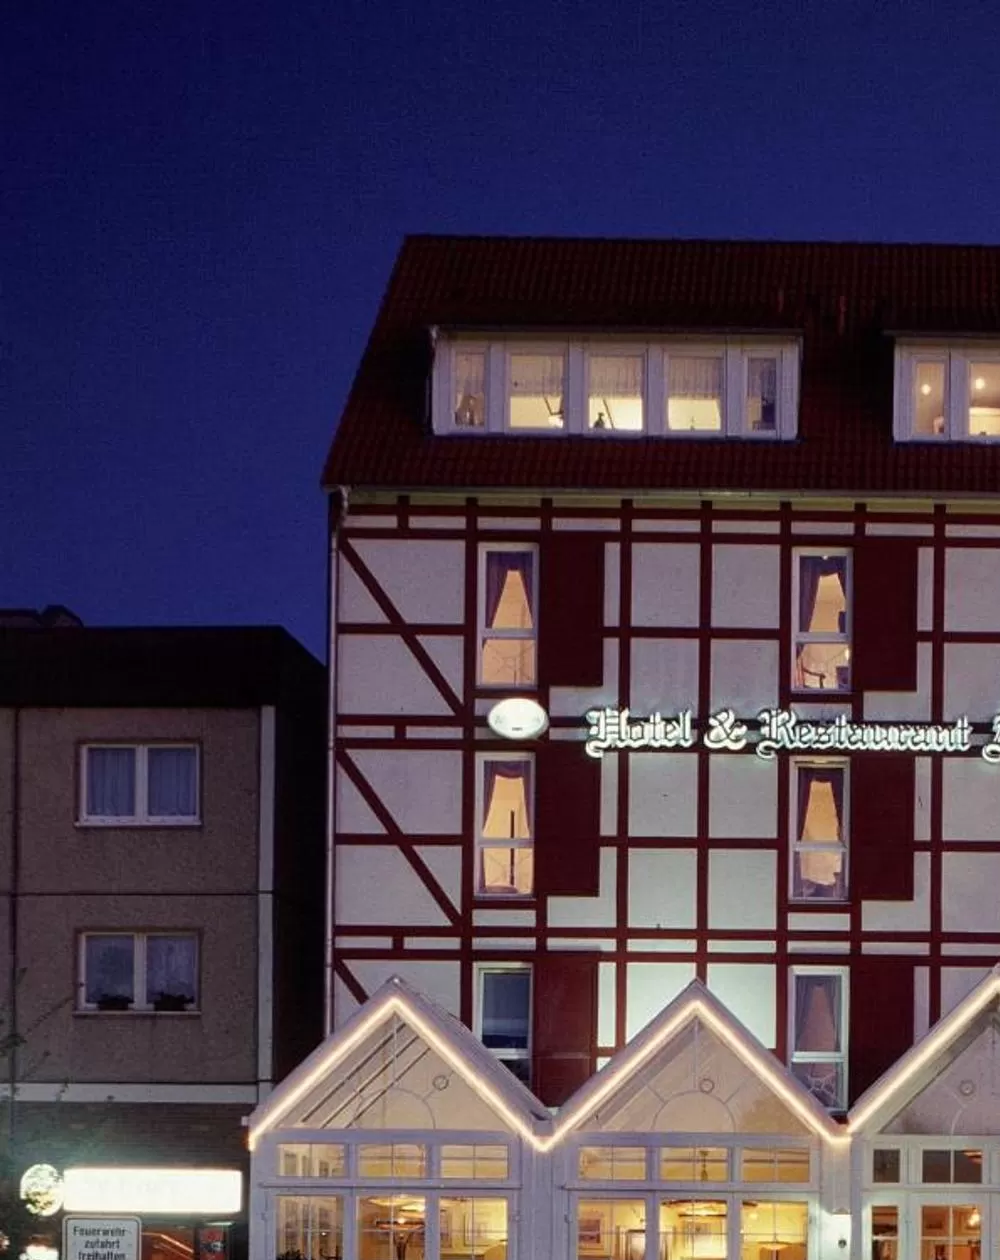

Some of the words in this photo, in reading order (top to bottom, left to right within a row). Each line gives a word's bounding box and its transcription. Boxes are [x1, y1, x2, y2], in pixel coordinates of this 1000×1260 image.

[586, 708, 692, 758] Hotel
[704, 708, 747, 750] &
[756, 708, 972, 758] Restaurant
[84, 1238, 120, 1249] zufahrt
[79, 1251, 125, 1260] freihalten
